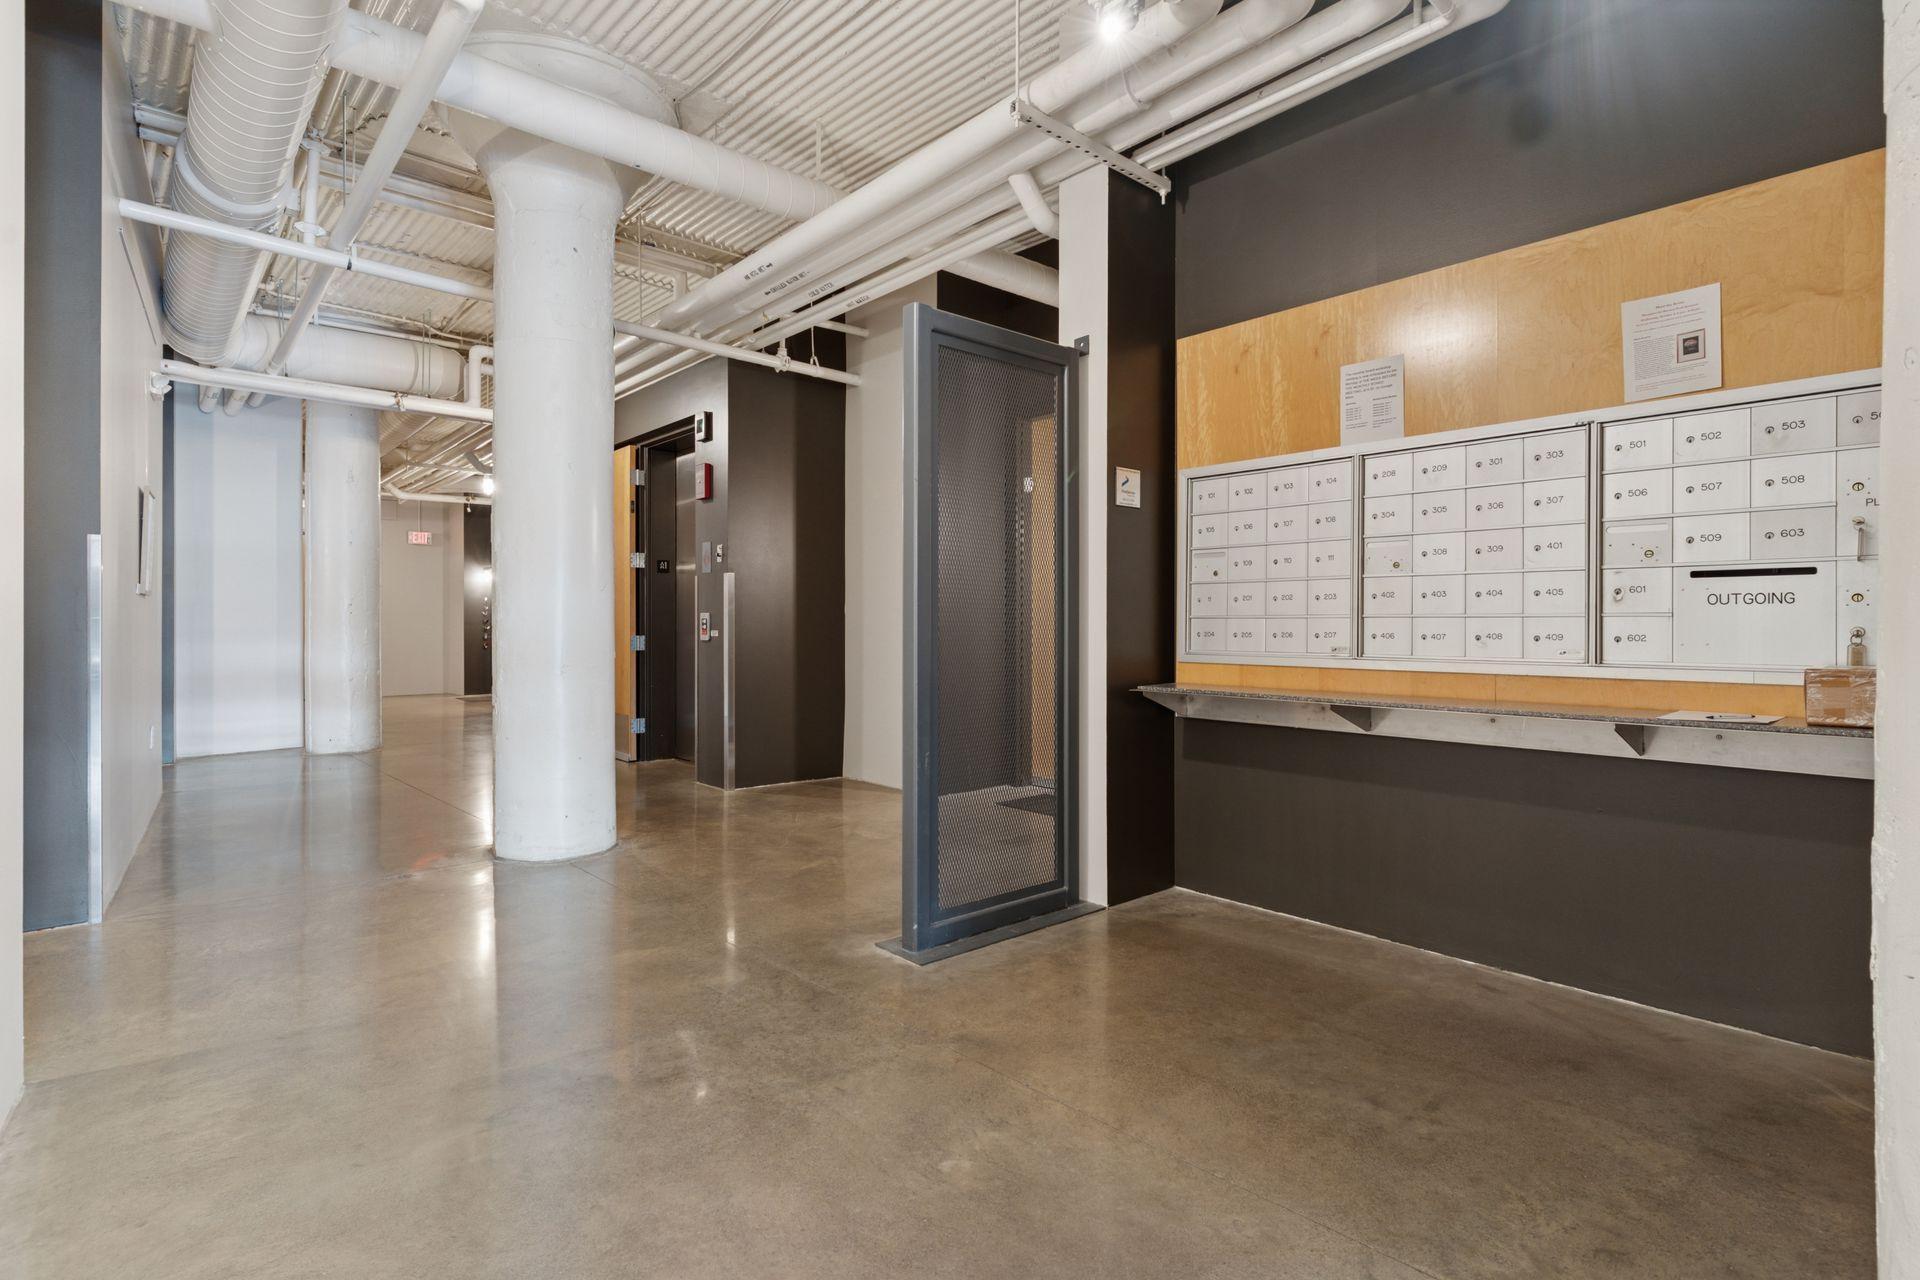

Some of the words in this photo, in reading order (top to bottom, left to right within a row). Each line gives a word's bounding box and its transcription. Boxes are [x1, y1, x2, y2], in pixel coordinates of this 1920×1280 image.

[1782, 420, 1805, 430] 503
[1701, 431, 1721, 440] 502
[1630, 440, 1646, 448] 501
[1546, 450, 1564, 459] 303
[1432, 464, 1447, 472] 209
[1782, 475, 1805, 484] 508
[1701, 482, 1722, 491] 507
[1628, 488, 1647, 497] 506
[1547, 496, 1563, 504] 307
[1781, 529, 1804, 537] 603
[412, 532, 428, 544] EXIT
[1700, 534, 1721, 542] 509
[1707, 592, 1795, 605] OUTGOING
[1627, 634, 1646, 642] 602
